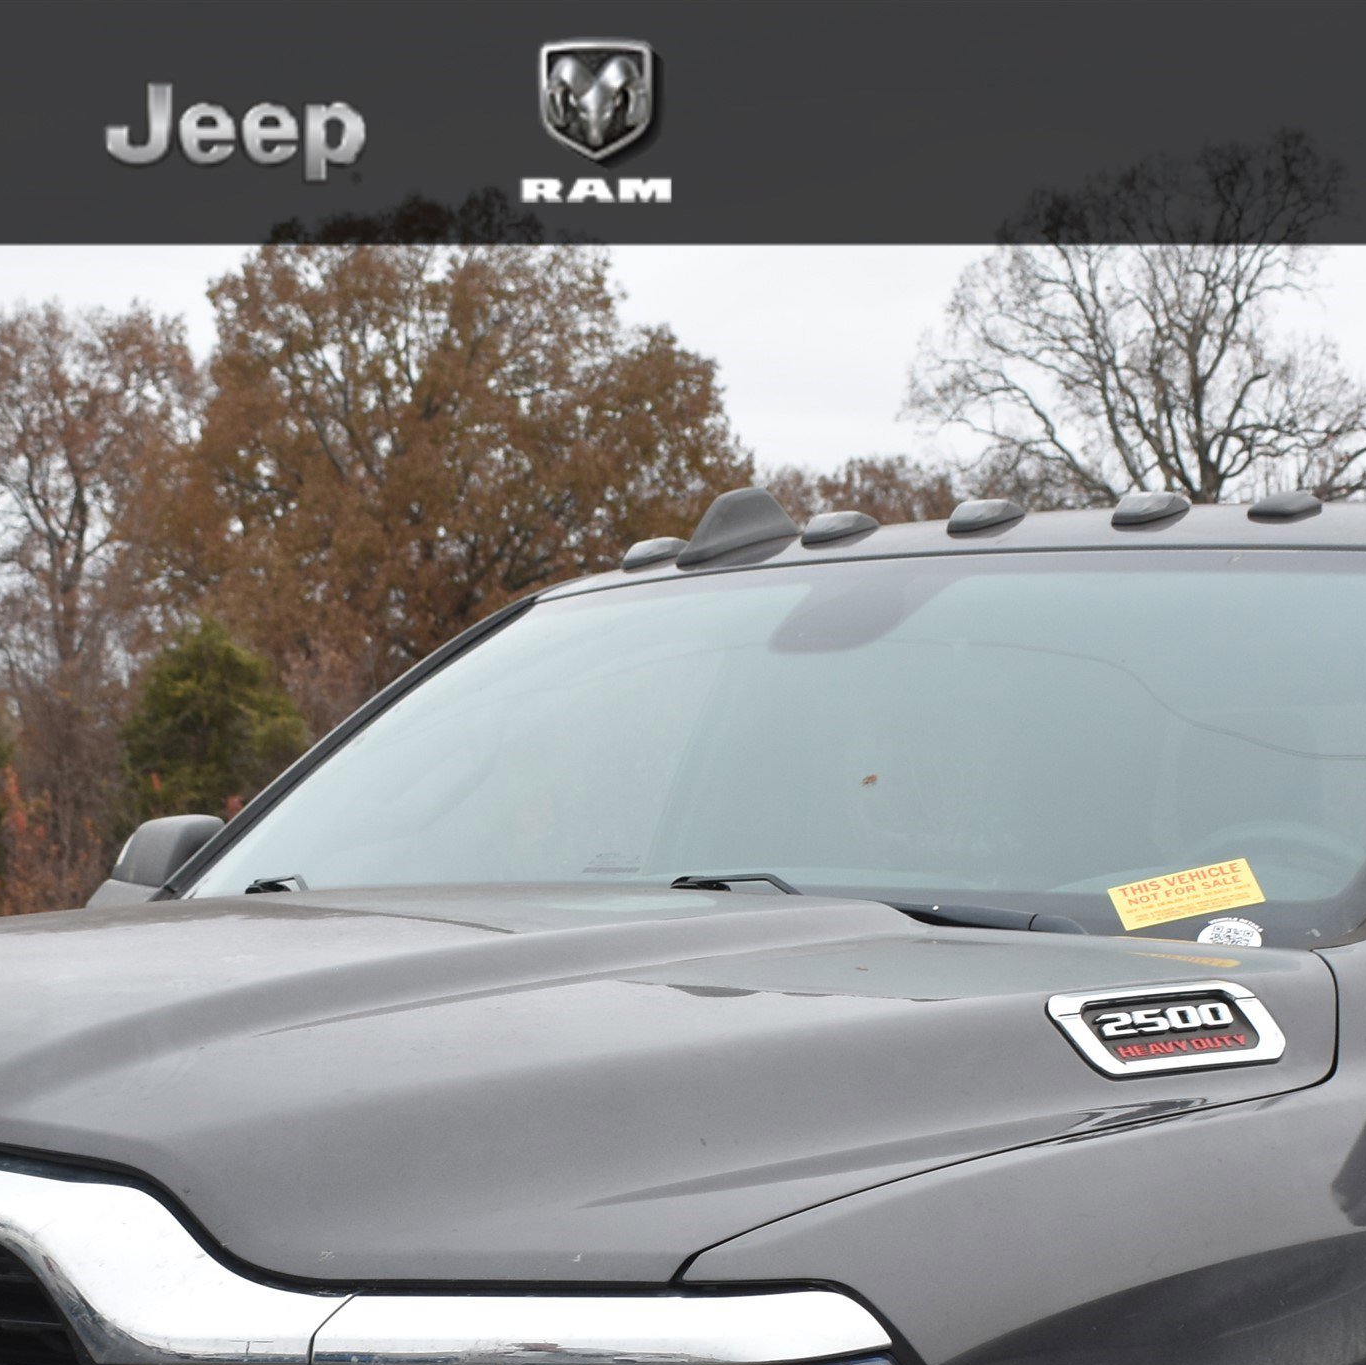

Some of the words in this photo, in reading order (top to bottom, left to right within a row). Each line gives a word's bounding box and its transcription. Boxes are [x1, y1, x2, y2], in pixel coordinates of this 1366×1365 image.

[1118, 880, 1161, 898] THIS
[1164, 862, 1242, 887] VEHICLE
[1128, 894, 1158, 907] NOT
[1165, 884, 1197, 898] FOR
[1201, 874, 1242, 890] SALE
[1092, 1001, 1235, 1039] 2500
[1116, 1040, 1190, 1059] HEAVY
[1191, 1033, 1247, 1051] DUTY
